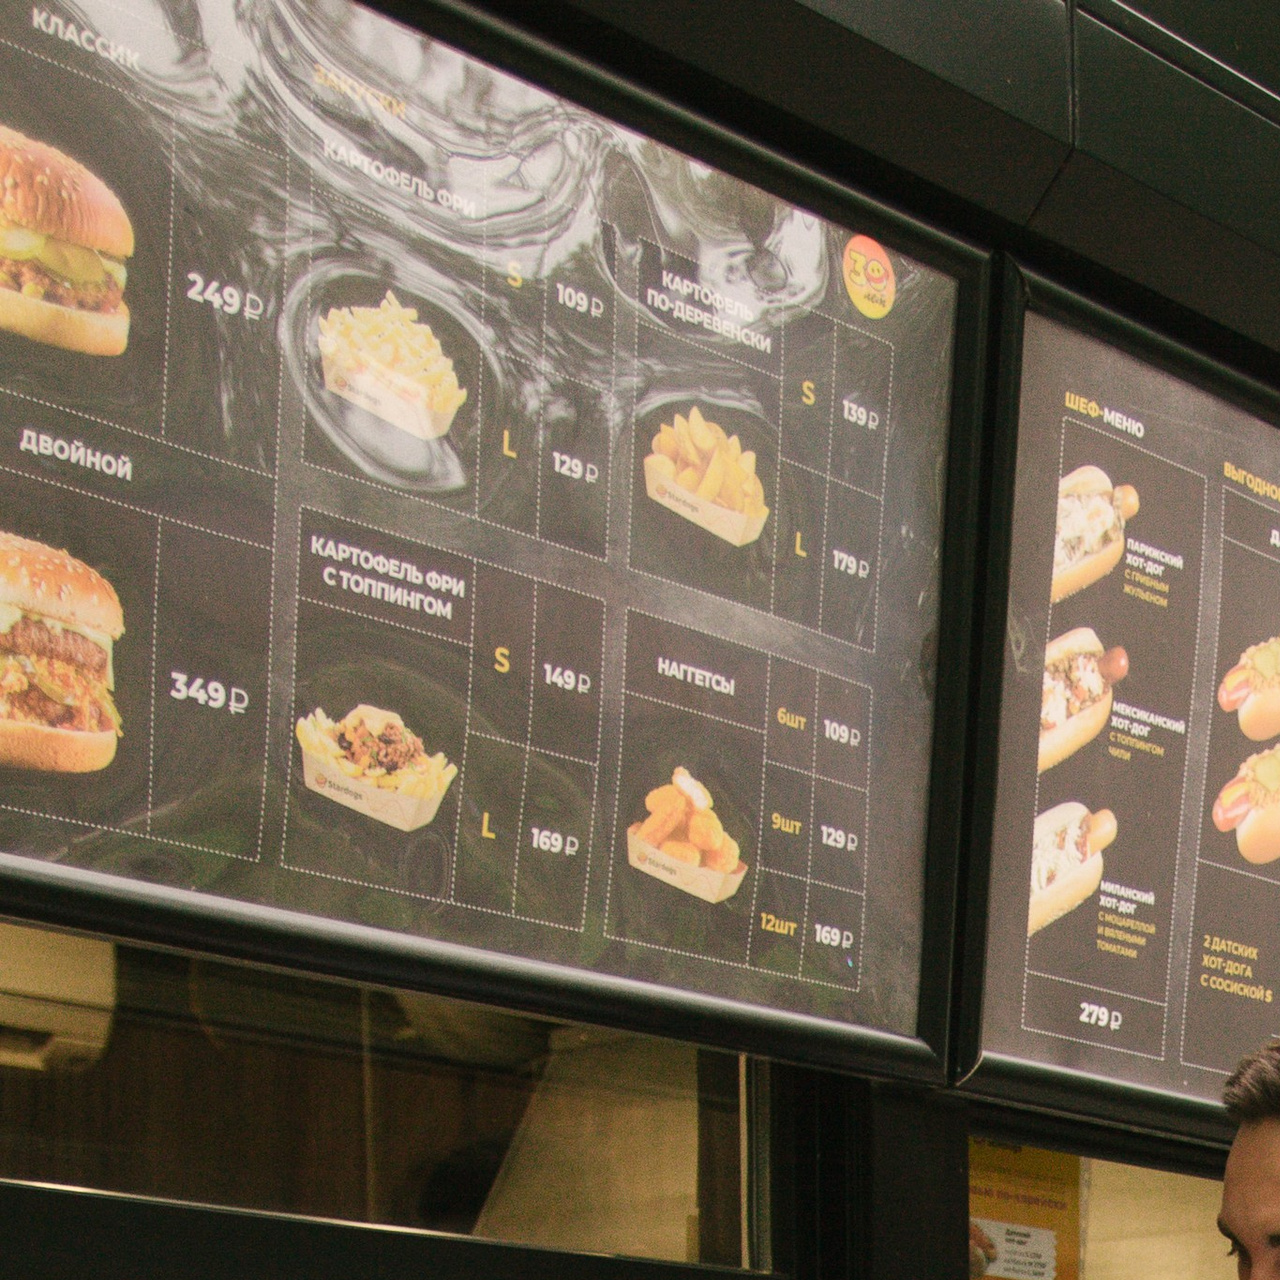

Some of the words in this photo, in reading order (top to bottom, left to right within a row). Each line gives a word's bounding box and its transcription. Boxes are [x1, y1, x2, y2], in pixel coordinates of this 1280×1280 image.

[32, 7, 140, 72] КЛАССИК
[323, 139, 435, 201] КАРТОФЕЛЬ
[436, 188, 476, 219] ФРИ
[507, 260, 522, 287] S
[662, 270, 754, 322] КАРТОФЕЛЬ
[647, 289, 772, 354] ПО-ДЕРЕВЕНСКИ
[802, 380, 816, 405] S
[1065, 391, 1145, 438] ШЕФ-МЕНЮ
[19, 428, 134, 482] ДВОЙНОЙ
[503, 429, 518, 458] L
[795, 532, 807, 558] L
[310, 535, 424, 585] КАРТОФЕЛЬ
[425, 566, 466, 599] ФРИ
[339, 570, 453, 620] ТОППИНГОМ
[493, 646, 510, 674] S
[658, 656, 735, 696] НАГГЕТСЫ
[777, 707, 807, 731] 6шт
[1112, 701, 1186, 735] МЕКСИКАНСКИЙ
[481, 811, 496, 840] L
[771, 811, 802, 836] 9шт
[760, 912, 797, 937] 12шт
[1203, 934, 1212, 948] 2
[1211, 936, 1258, 961] ДАТСКИХ
